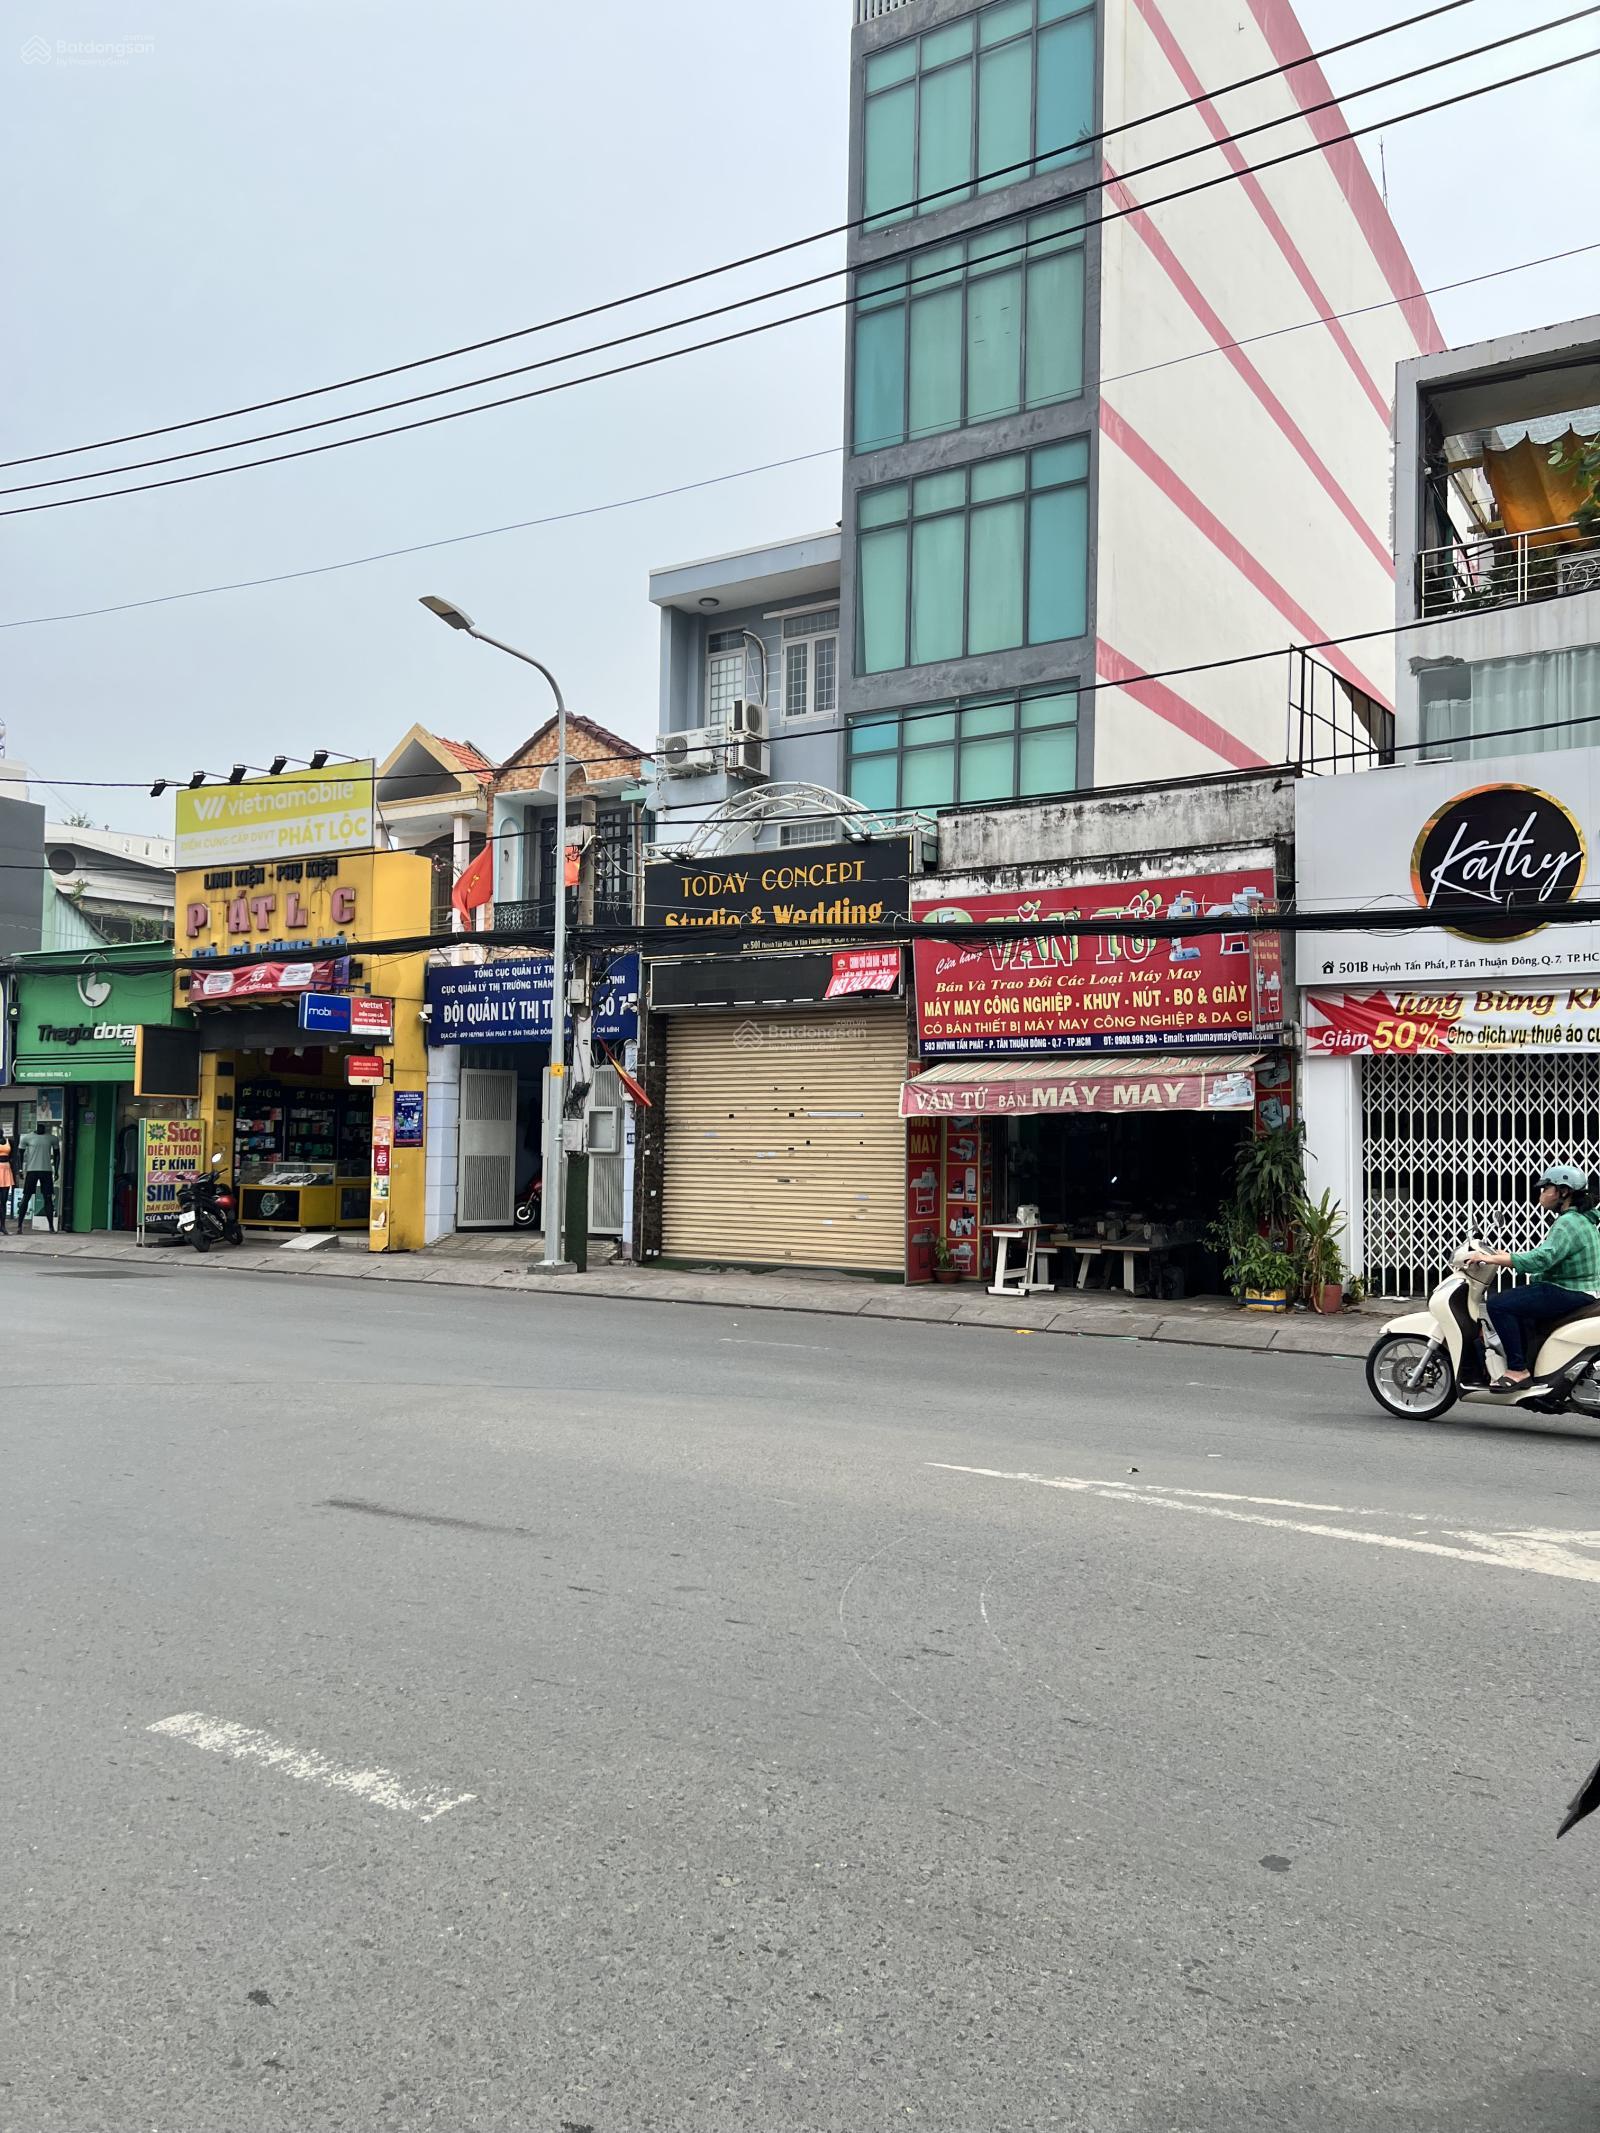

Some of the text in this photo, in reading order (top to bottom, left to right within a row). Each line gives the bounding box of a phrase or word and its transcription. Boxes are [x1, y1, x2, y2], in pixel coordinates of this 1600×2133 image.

[228, 780, 354, 816] vietnamobile
[277, 818, 326, 847] PHÁT
[328, 812, 367, 845] LỘC
[204, 858, 338, 890] LINH KIỆN PHỤ KIỆN
[1426, 811, 1584, 909] Kathy
[681, 860, 866, 898] TODAY CONCEPT
[665, 897, 884, 927] Studio & Wedding
[751, 941, 761, 949] 501
[986, 900, 1081, 971] VĂN
[474, 965, 494, 978] TỔNG
[495, 968, 510, 979] CỤC
[512, 963, 532, 976] QUẢN
[533, 963, 542, 975] LÝ
[1339, 961, 1368, 974] 501B
[1372, 961, 1401, 974] Huỳnh
[1405, 959, 1421, 970] Tấn
[1424, 958, 1448, 970] Phát,
[1450, 960, 1456, 968] P.
[1458, 957, 1476, 969] Tân
[1478, 956, 1508, 970] Thuận
[1511, 954, 1540, 968] Đông,
[441, 977, 554, 996] CỤC QUẢN LÝ THỊ TRƯỜNG THÀN
[936, 967, 1202, 993] Bán Và Trao Đổi Các Loại Máy May
[443, 1000, 464, 1027] ĐỘI
[467, 996, 499, 1025] QUẢN
[502, 997, 517, 1020] LÝ
[519, 1000, 539, 1024] THỊ
[924, 980, 1247, 1017] MÁY MAY CÔNG NGHIỆP KHUY NÚT BO & GIÀY
[1473, 989, 1556, 1017] Bừng
[946, 1020, 971, 1034] BÁN
[975, 1018, 1006, 1033] THIẾT
[1010, 1021, 1021, 1033] BỊ
[1024, 1018, 1055, 1032] MÁY
[1059, 1018, 1089, 1030] MAY
[1093, 1012, 1136, 1028] CÔNG
[1140, 1011, 1194, 1027] NGHIỆP
[1198, 1012, 1207, 1024] &
[1211, 1011, 1233, 1024] DA
[1236, 1010, 1252, 1022] GI
[1322, 1029, 1369, 1047] Giảm
[1372, 1021, 1439, 1049] 50%
[1447, 1026, 1474, 1044] Cho
[1478, 1025, 1506, 1049] dịch
[1511, 1028, 1527, 1048] vụ
[1531, 1024, 1562, 1044] thuê
[1565, 1024, 1583, 1043] áo
[936, 1038, 956, 1051] HUỲNH
[956, 1038, 968, 1050] TẤN
[968, 1038, 984, 1049] PHÁT
[989, 1040, 996, 1048] P.
[996, 1037, 1008, 1048] TÂN
[1009, 1037, 1029, 1050] THUẬN
[1030, 1035, 1047, 1047] ĐÔNG
[1051, 1037, 1061, 1048] Q.7
[1067, 1036, 1092, 1047] TP.HCM
[1115, 1034, 1144, 1045] 0908.996
[1145, 1033, 1158, 1044] 294
[1163, 1032, 1185, 1043] Email:
[915, 1081, 1186, 1110] VĂN TỨ BÁN MÁY MAY
[167, 1121, 202, 1142] Sửa
[911, 1134, 938, 1153] MAY
[152, 1157, 196, 1171] ÉP KÍNH
[147, 1184, 176, 1202] SIM
